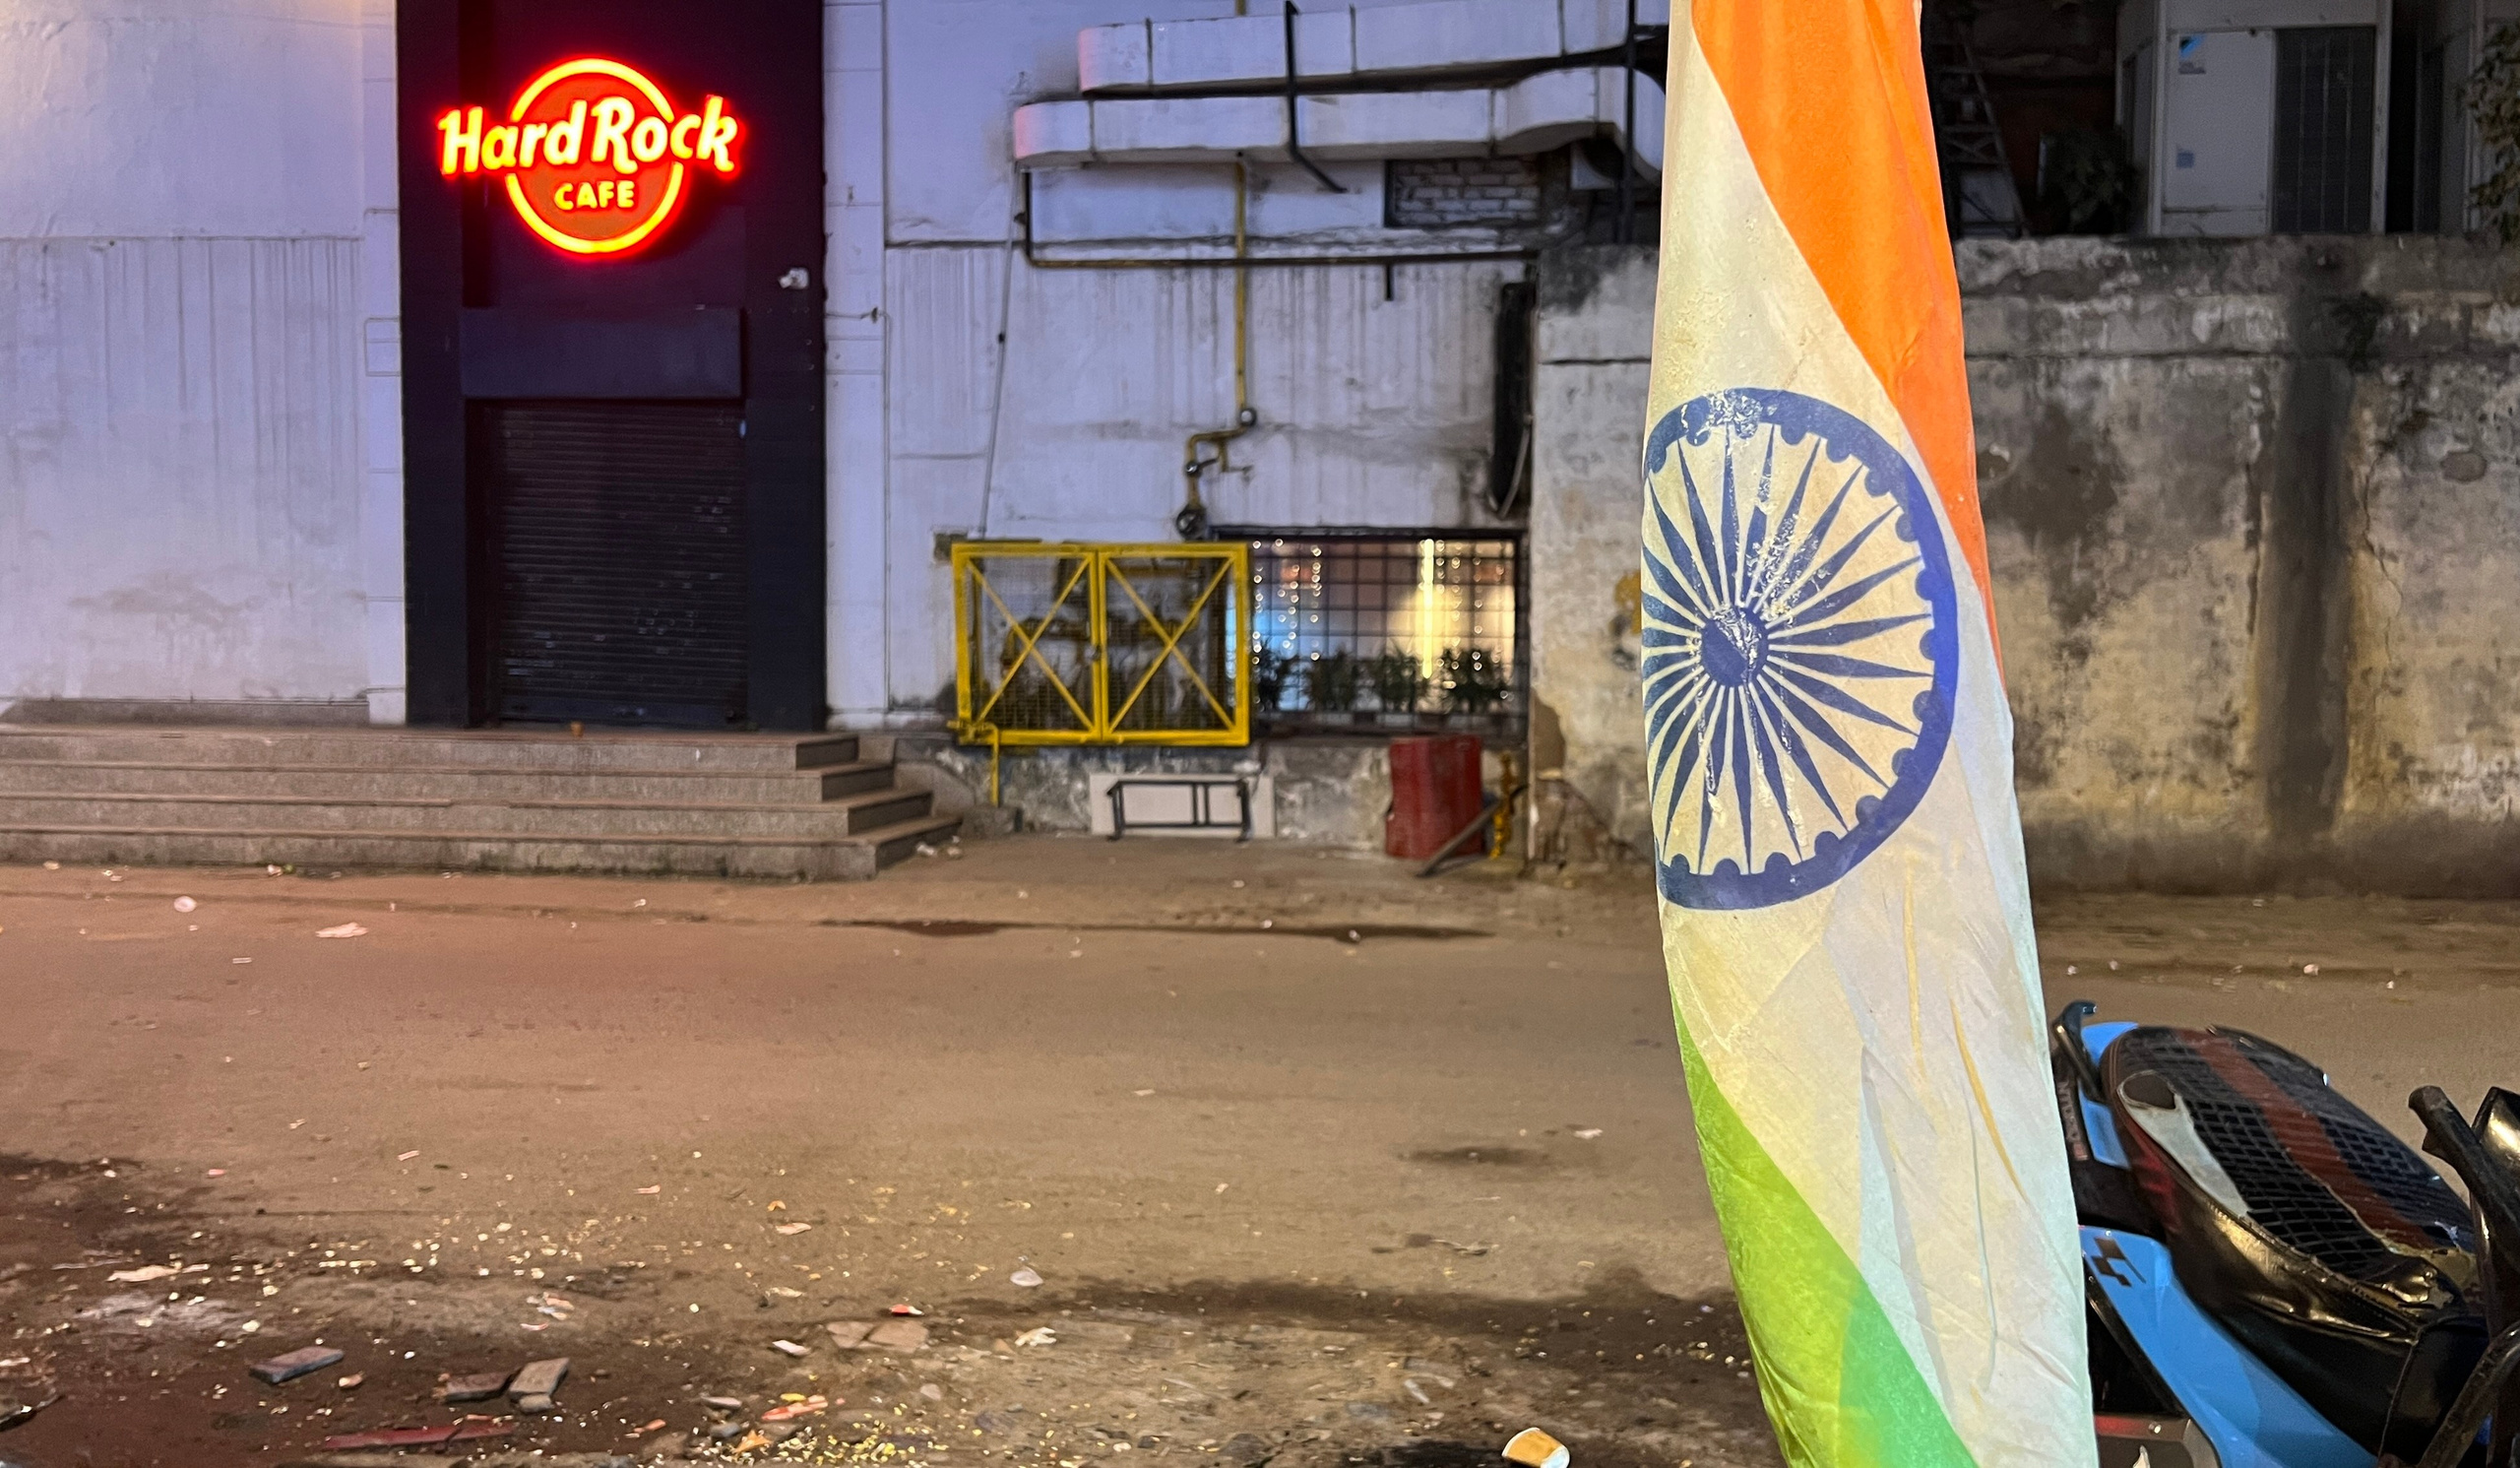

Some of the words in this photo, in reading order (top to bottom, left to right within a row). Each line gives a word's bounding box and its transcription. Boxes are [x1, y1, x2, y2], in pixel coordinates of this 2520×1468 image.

[438, 99, 588, 174] Hard
[591, 96, 737, 173] Rock
[554, 180, 635, 210] CAFE
